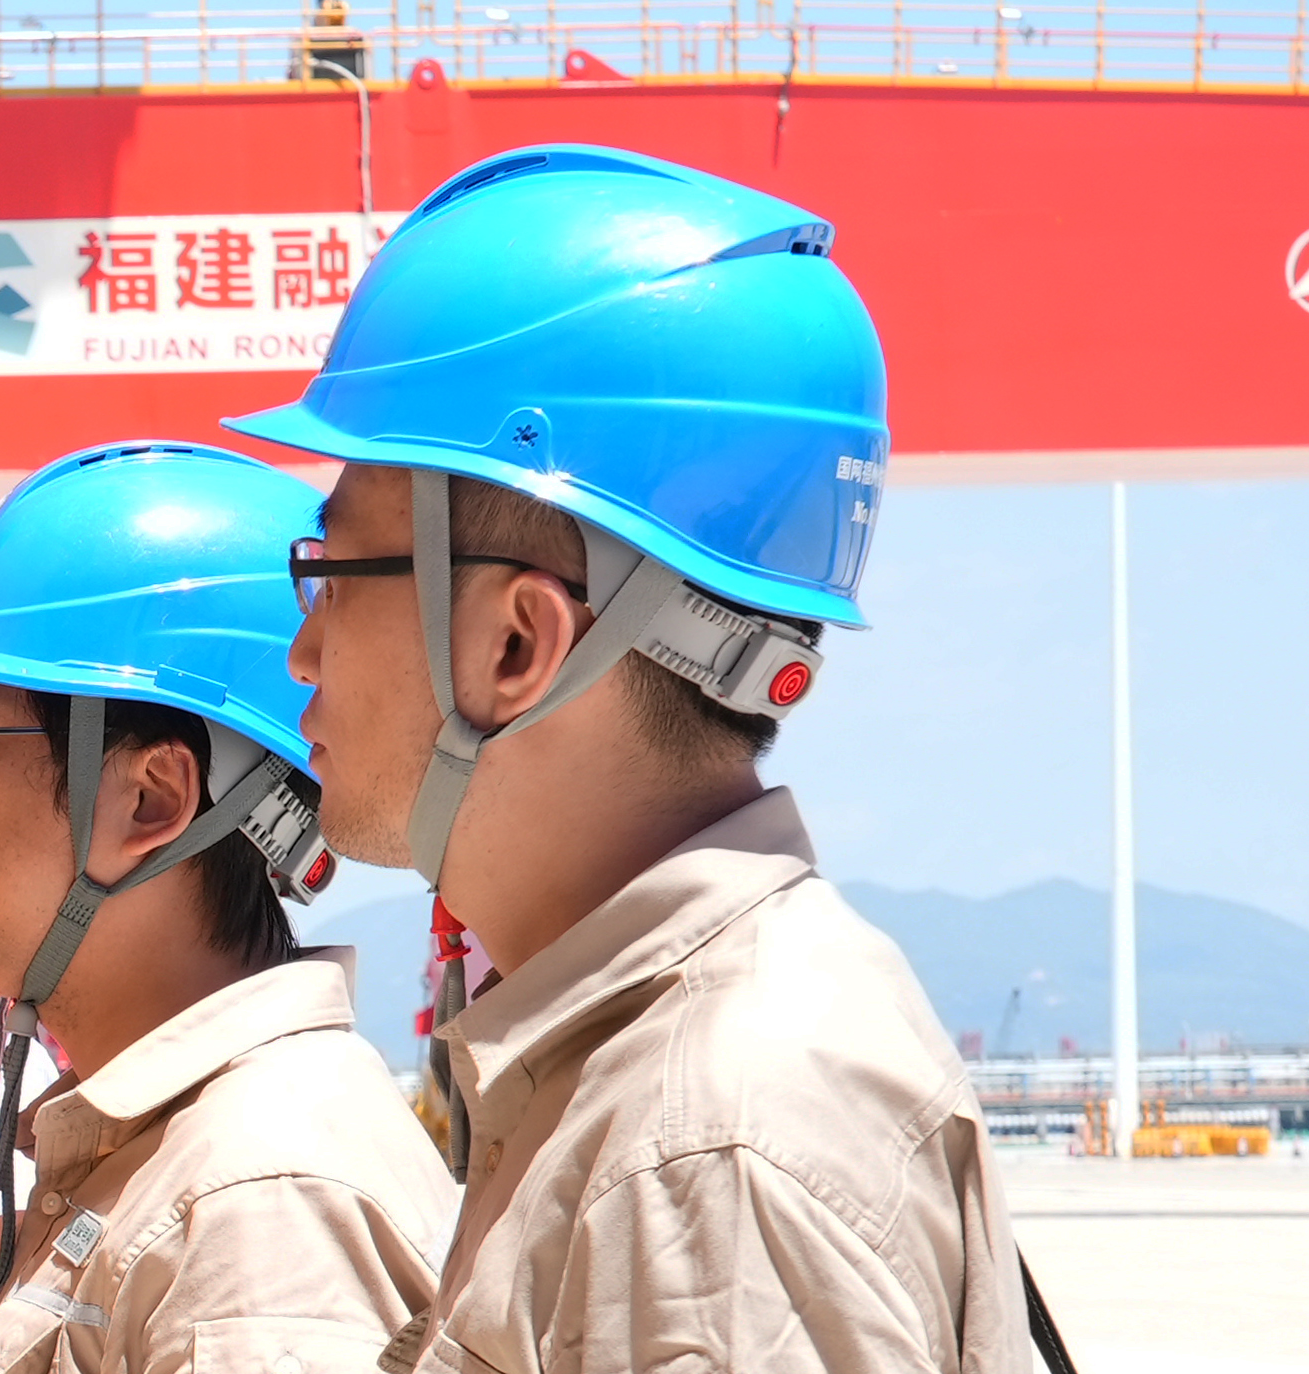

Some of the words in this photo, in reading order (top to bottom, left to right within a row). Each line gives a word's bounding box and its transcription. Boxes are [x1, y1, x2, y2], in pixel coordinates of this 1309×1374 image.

[78, 226, 386, 313] 福建融
[83, 336, 209, 363] FUJIAN
